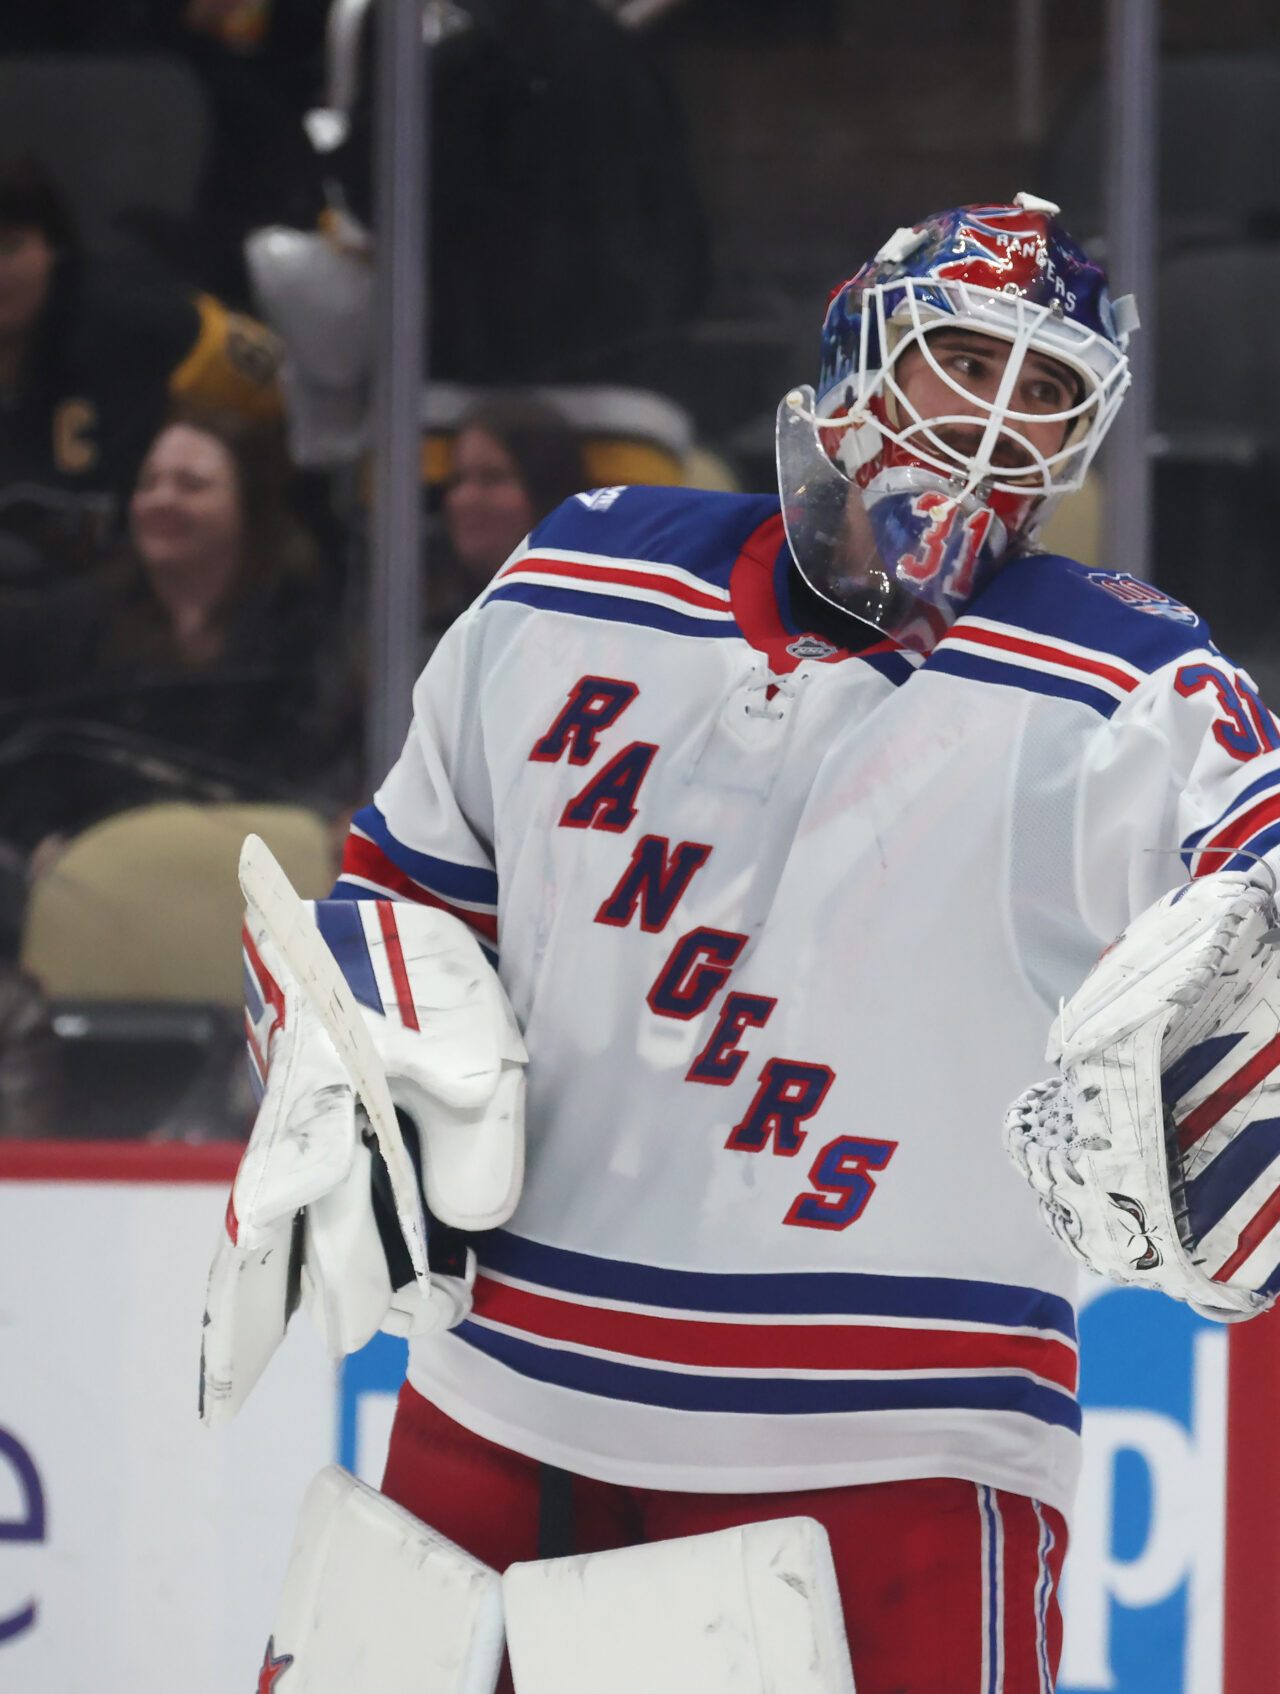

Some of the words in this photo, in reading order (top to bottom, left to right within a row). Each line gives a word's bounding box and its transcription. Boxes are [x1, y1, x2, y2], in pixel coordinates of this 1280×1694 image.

[996, 234, 1077, 312] RANGERS
[896, 490, 994, 599] 31
[528, 674, 899, 1231] RANGERS
